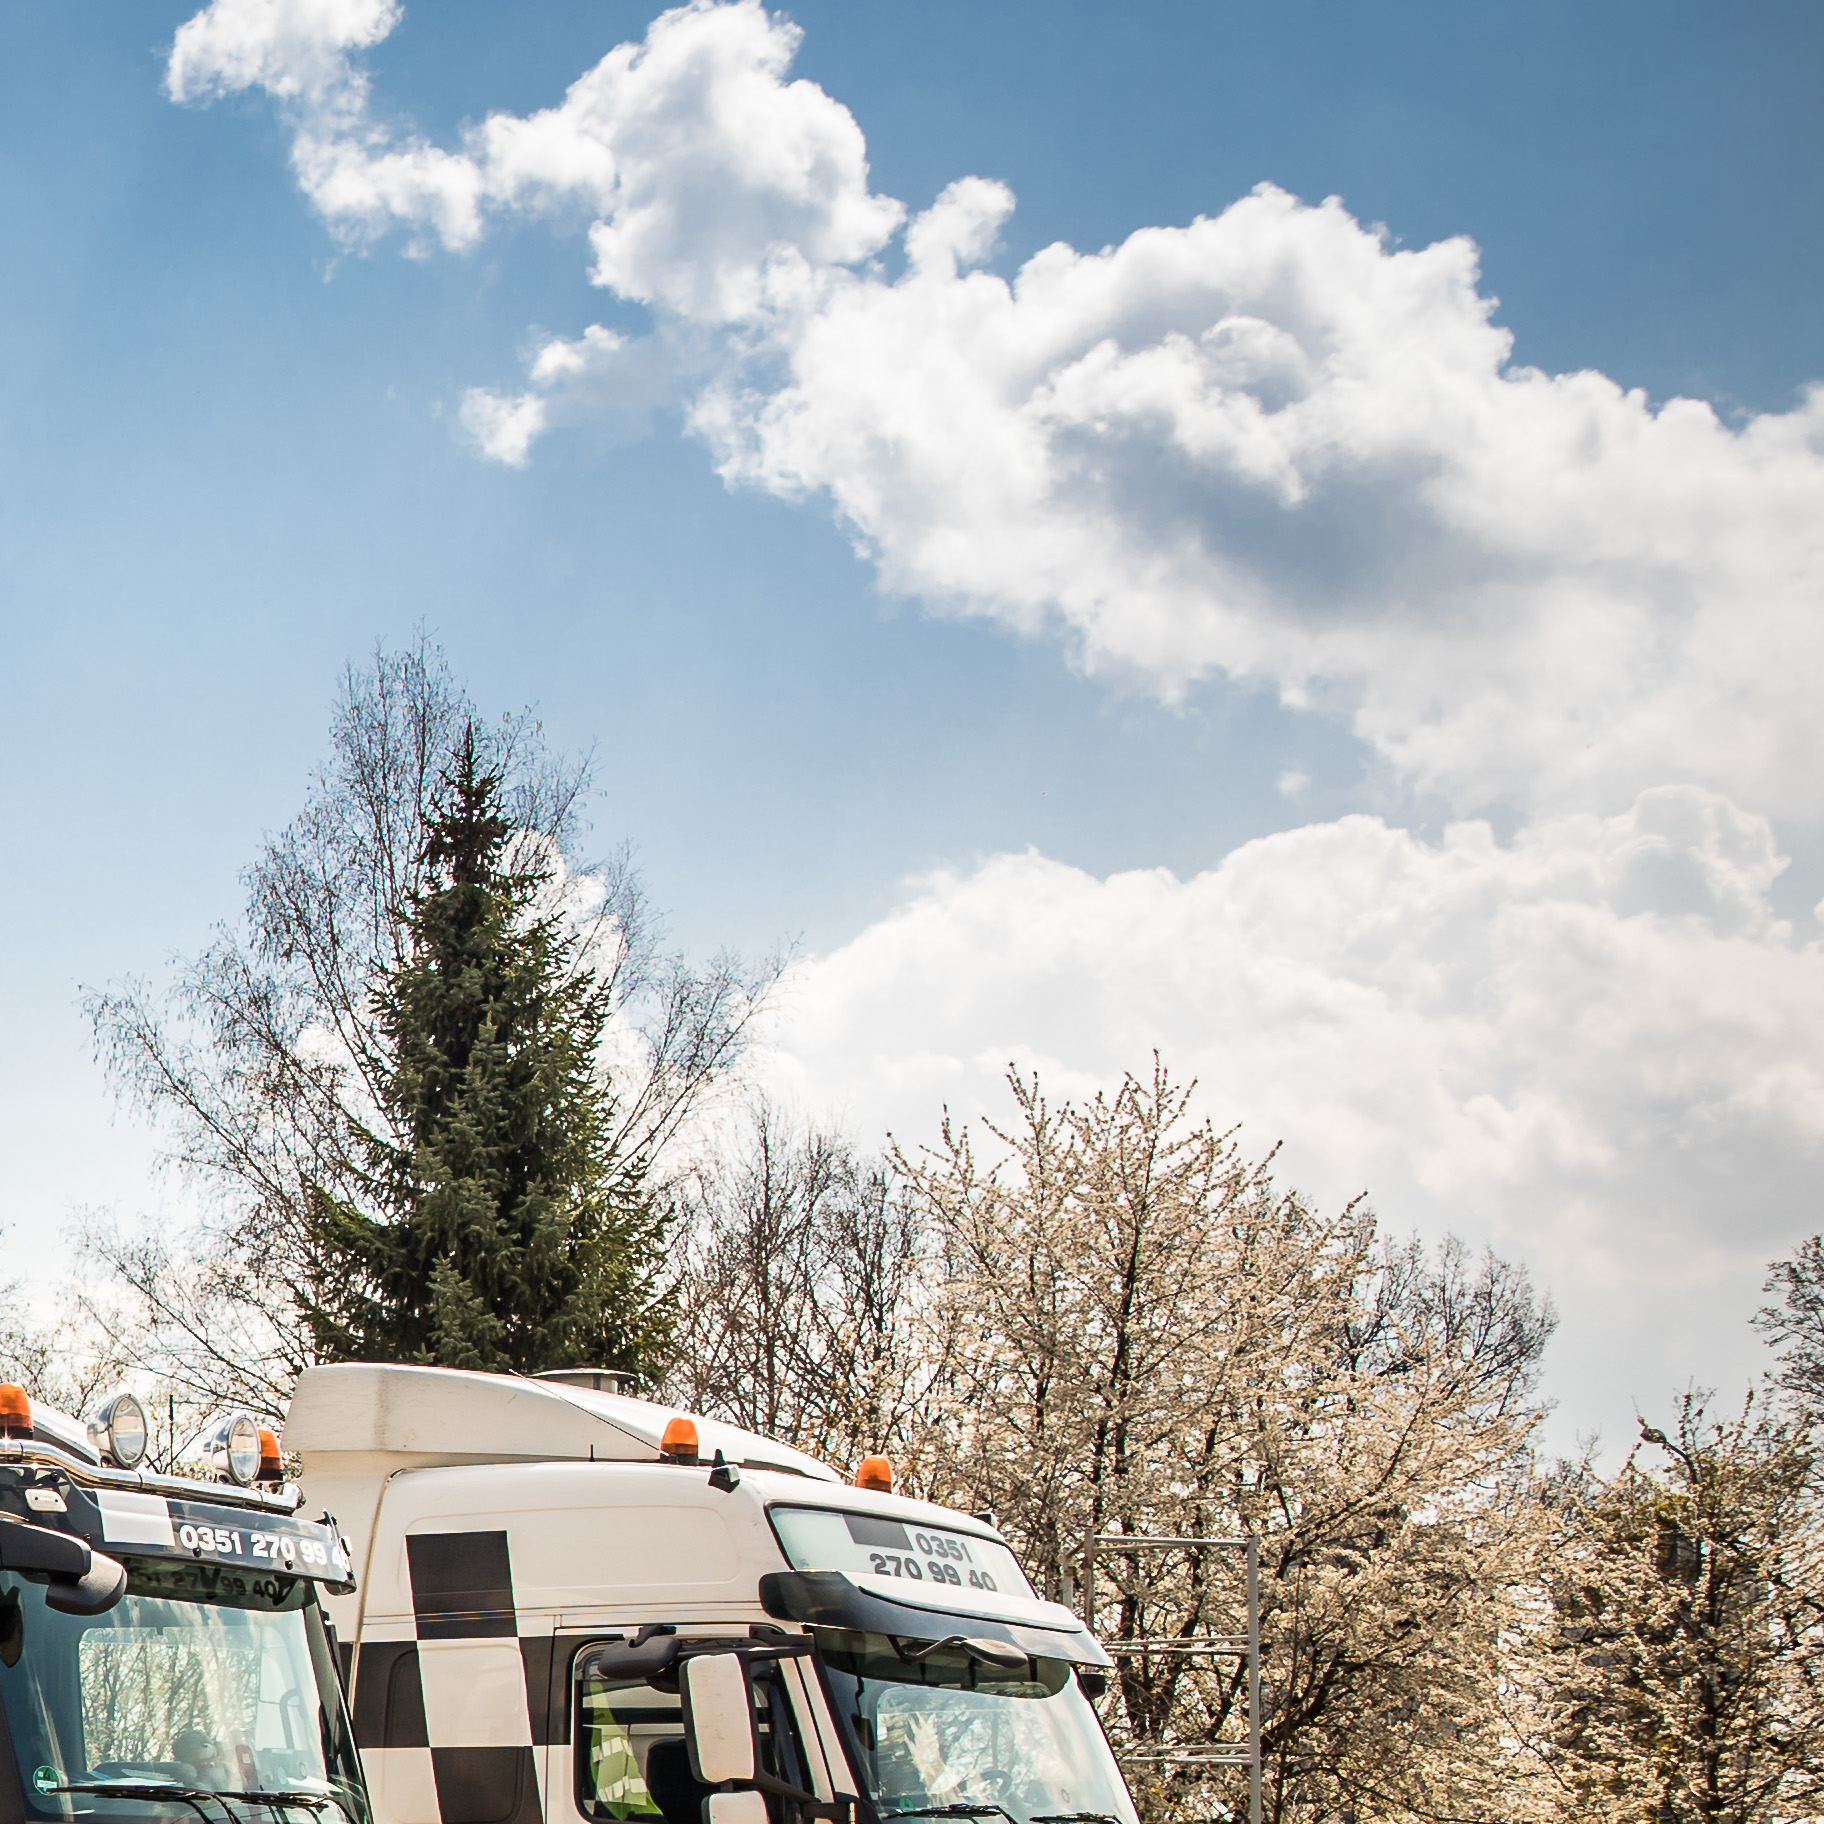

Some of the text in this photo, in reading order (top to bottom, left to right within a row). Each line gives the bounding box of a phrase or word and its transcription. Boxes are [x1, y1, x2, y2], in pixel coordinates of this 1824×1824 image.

[179, 1524, 243, 1555] 0351
[250, 1534, 296, 1561] 270
[300, 1539, 328, 1566] 99
[915, 1532, 974, 1564] 0351
[870, 1553, 998, 1592] 270 99 40
